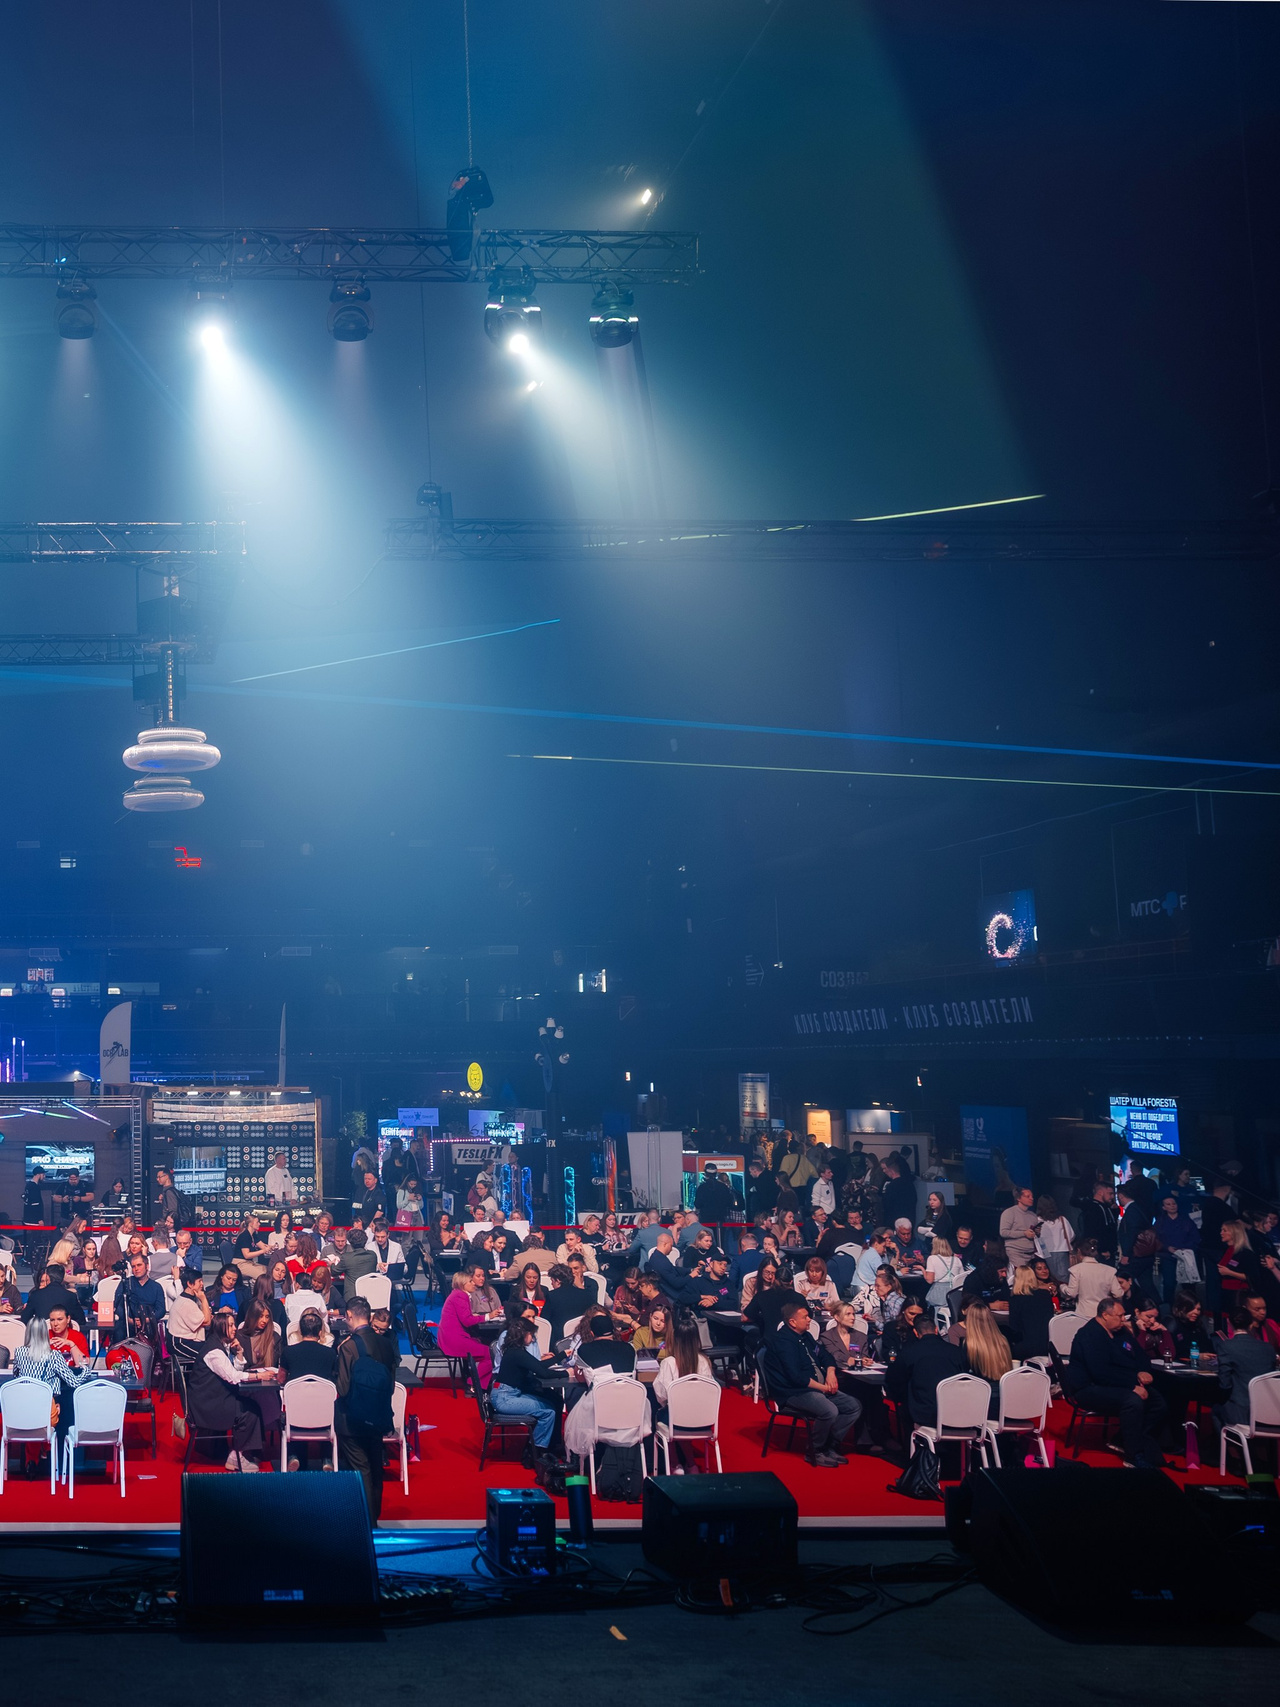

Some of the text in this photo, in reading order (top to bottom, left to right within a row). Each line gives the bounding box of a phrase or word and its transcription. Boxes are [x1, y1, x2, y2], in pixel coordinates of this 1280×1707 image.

[793, 996, 1034, 1035] КЛУБ СОЗДАТЕЛИ КЛУБ СОЗДАТЕЛИ
[1109, 1096, 1177, 1108] ШАТЕР VILLA FORESTA
[457, 1146, 504, 1159] TESLAFX
[101, 1307, 110, 1315] 15
